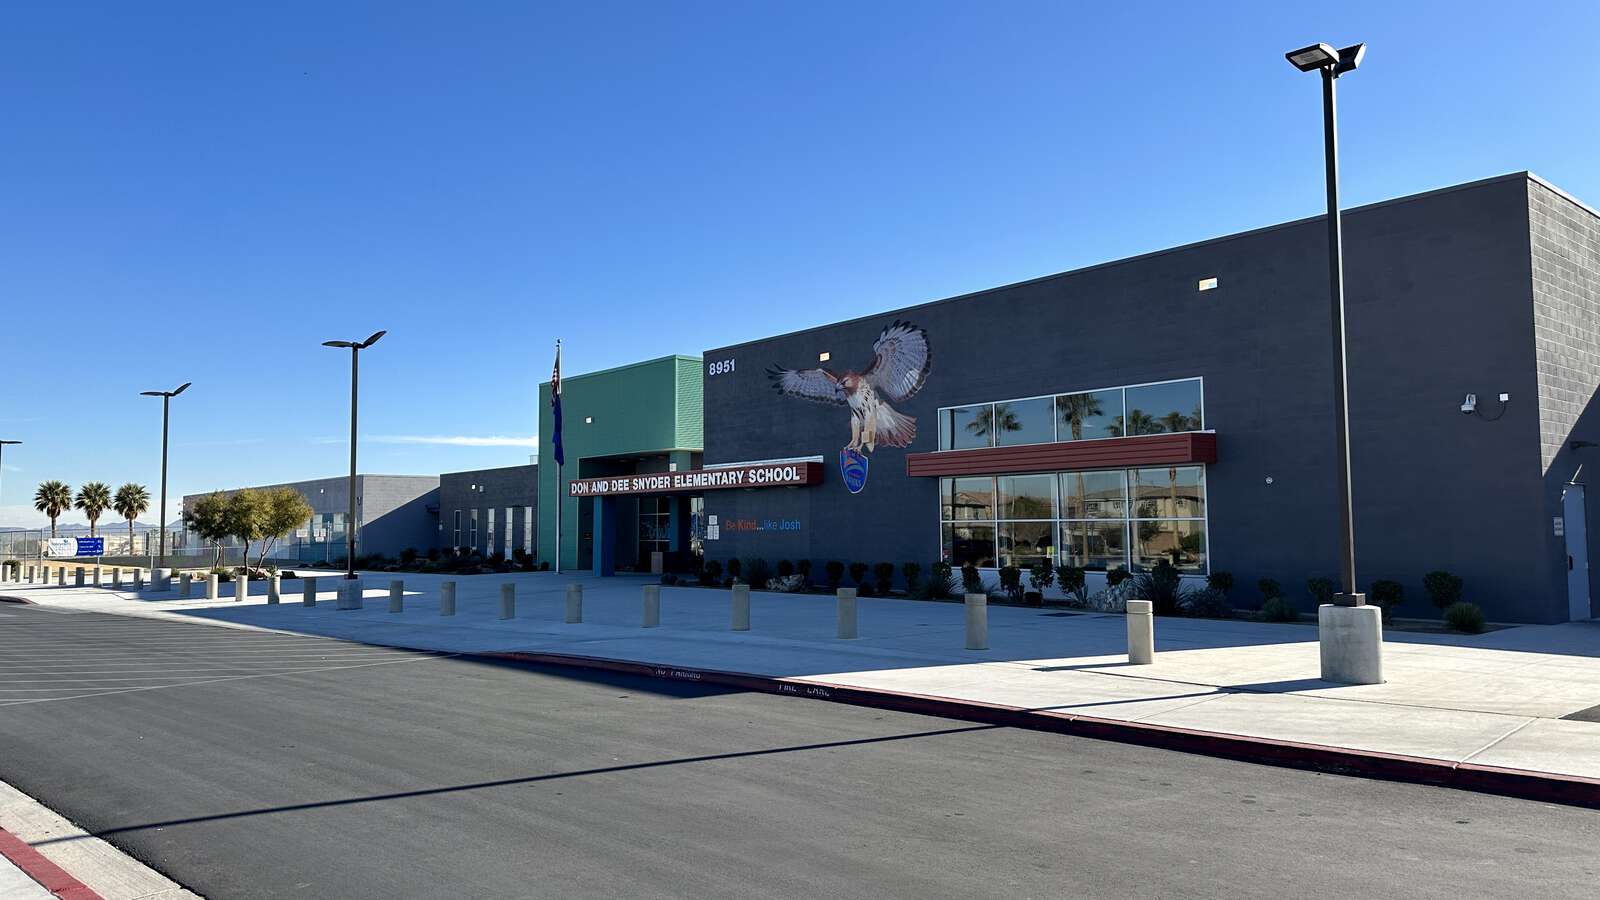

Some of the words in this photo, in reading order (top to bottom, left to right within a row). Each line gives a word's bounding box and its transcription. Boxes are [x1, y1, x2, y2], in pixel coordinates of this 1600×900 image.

[709, 359, 735, 375] 8951
[571, 482, 589, 494] DON
[591, 480, 609, 493] AND
[611, 479, 630, 492] DEE
[632, 476, 671, 490] SNYDER
[674, 470, 744, 488] ELEMENTARY
[748, 466, 800, 484] SCHOOL
[780, 519, 801, 530] Josh
